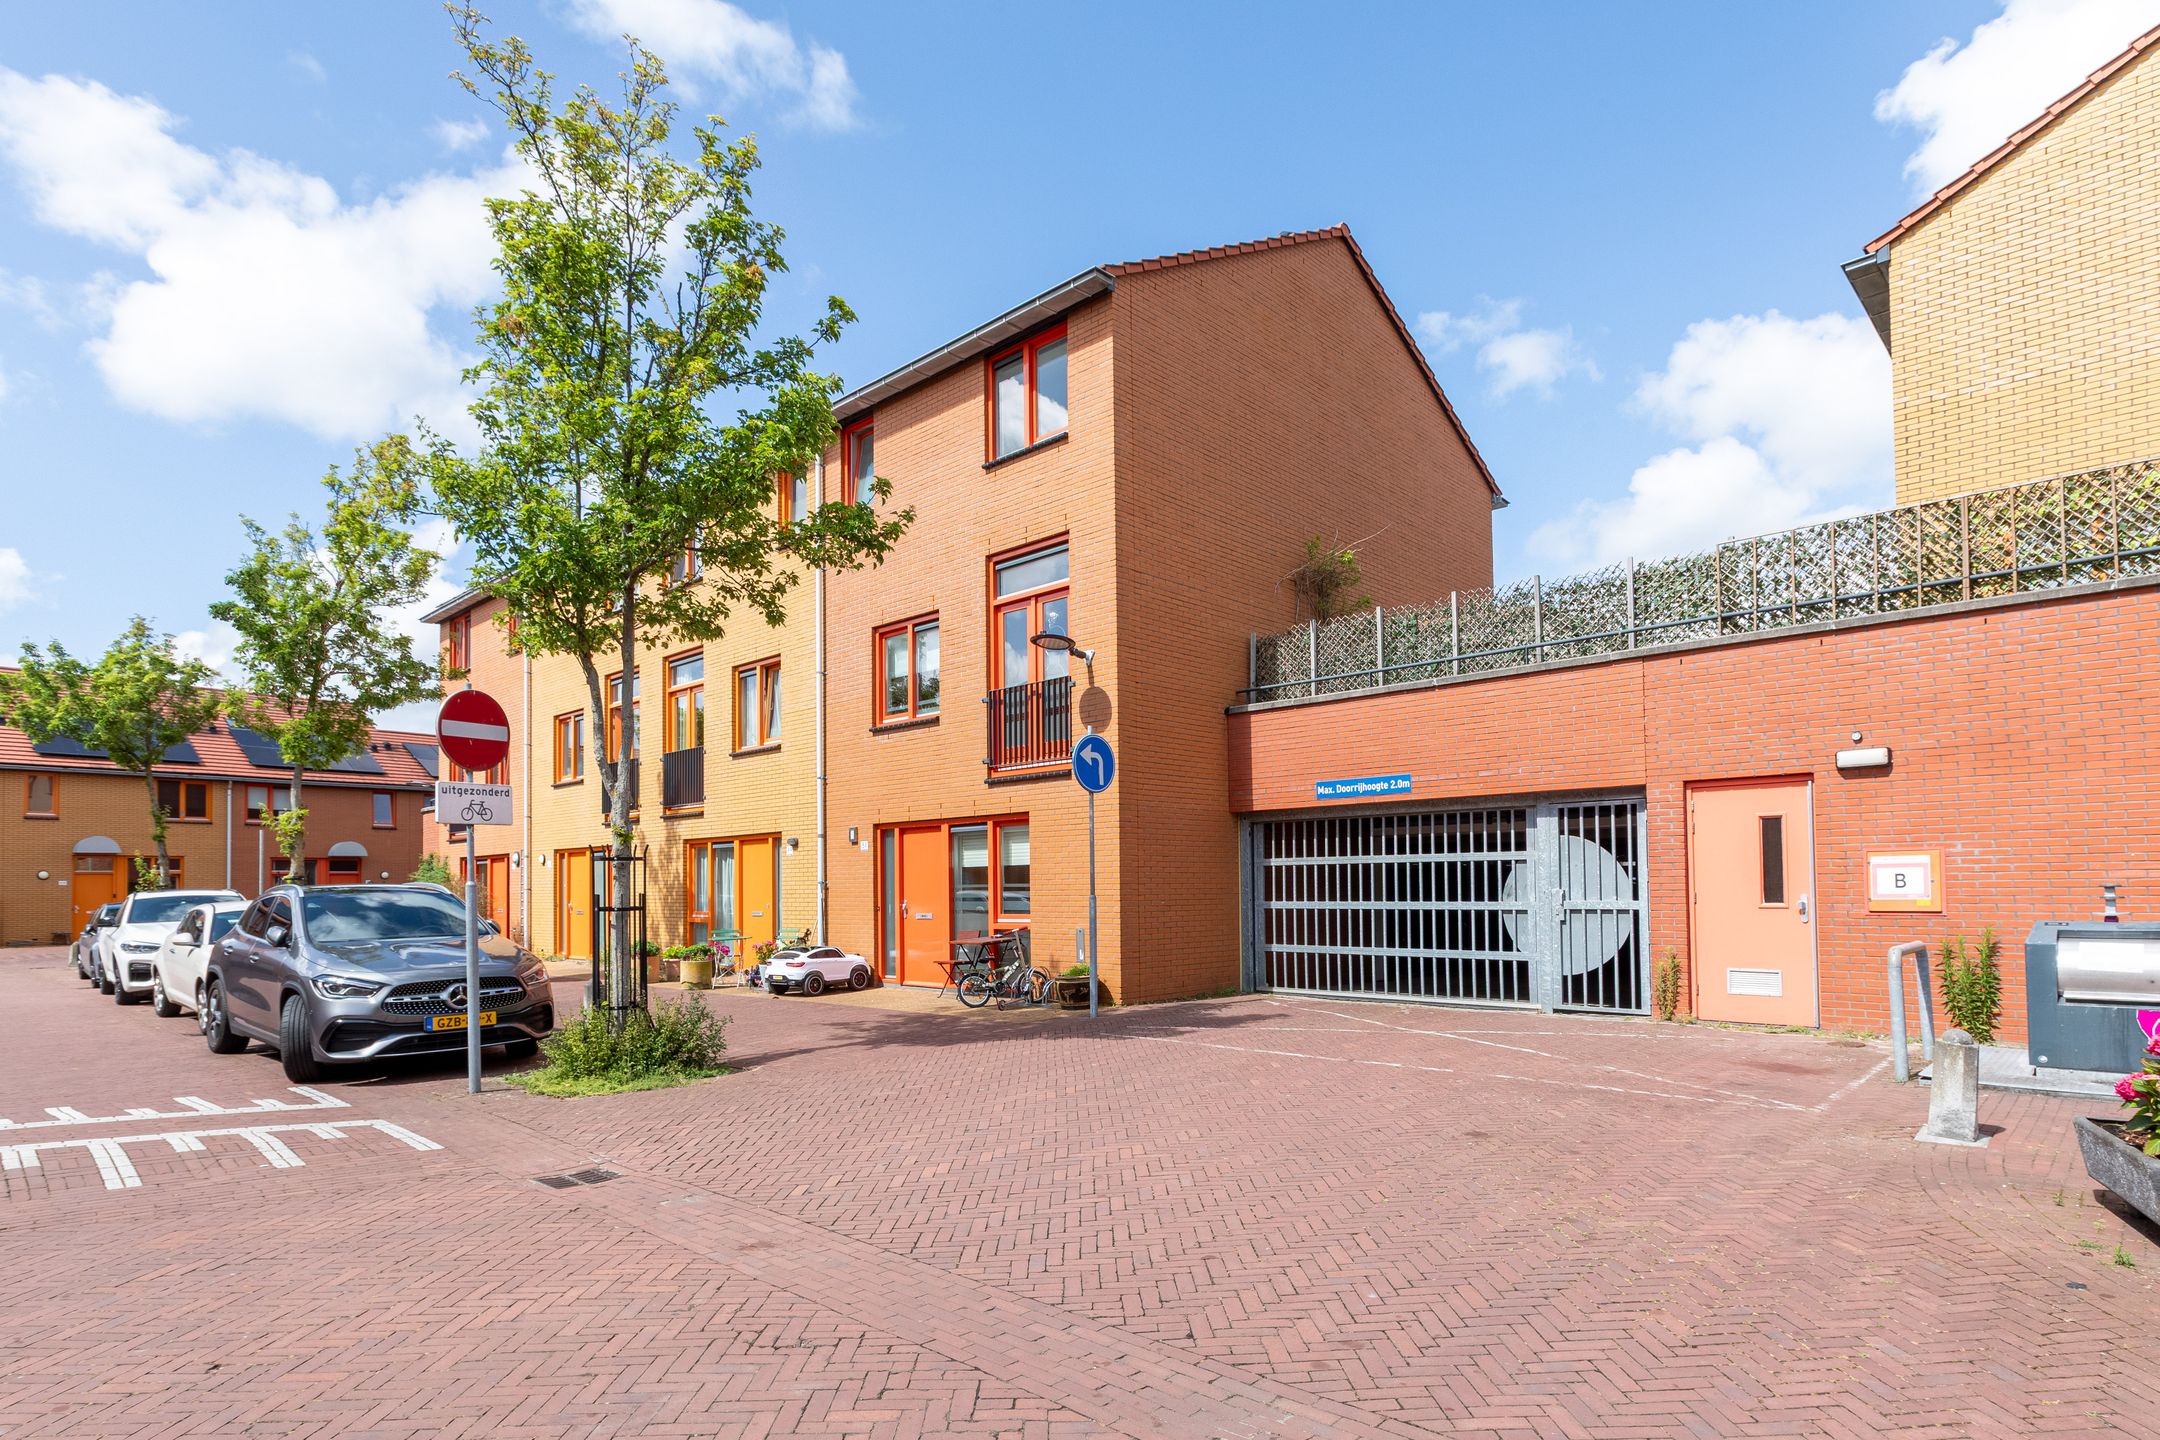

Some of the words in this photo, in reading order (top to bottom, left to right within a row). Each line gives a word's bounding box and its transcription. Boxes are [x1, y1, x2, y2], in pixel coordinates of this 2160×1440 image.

[441, 785, 510, 798] uitgezonderd
[1317, 786, 1335, 795] Max.
[1336, 781, 1389, 793] Doorrijhoogte
[1390, 779, 1410, 789] 2.0m
[1895, 873, 1906, 888] B
[437, 1013, 493, 1028] GZB--X
